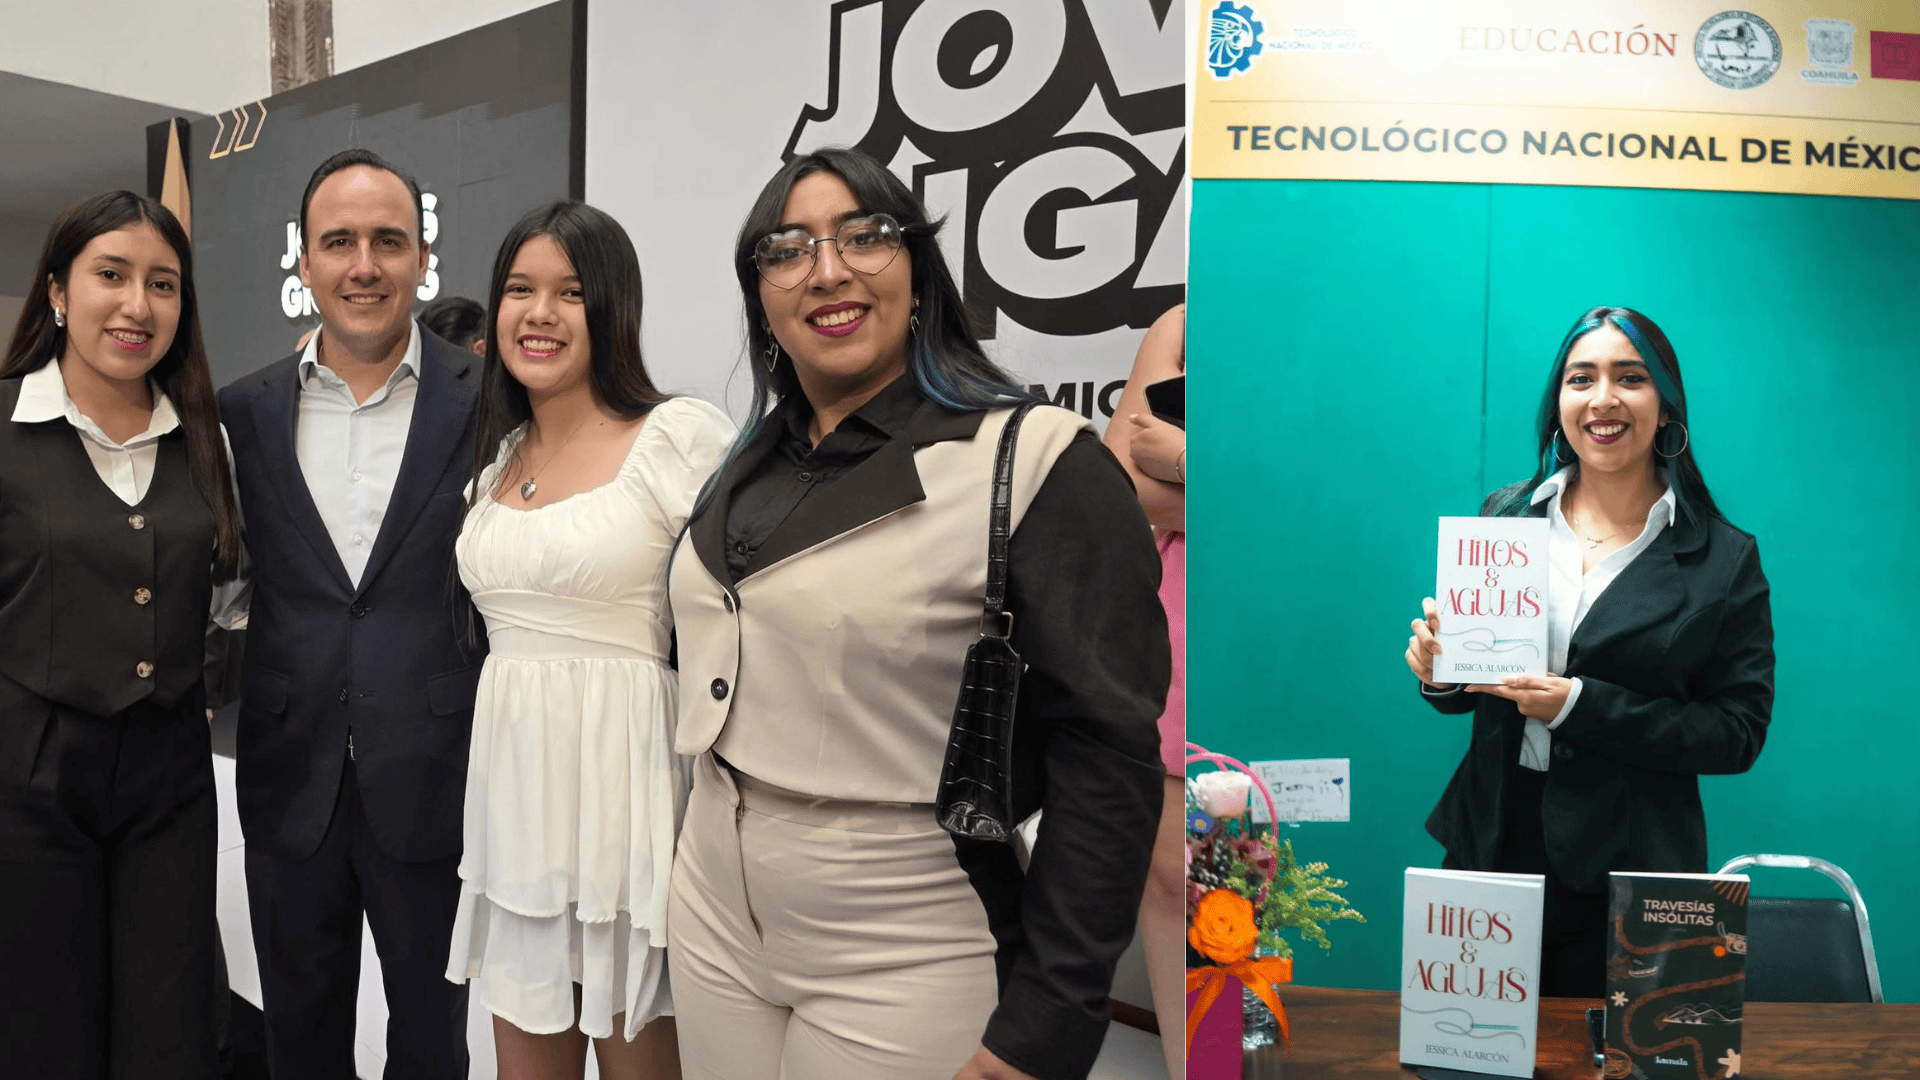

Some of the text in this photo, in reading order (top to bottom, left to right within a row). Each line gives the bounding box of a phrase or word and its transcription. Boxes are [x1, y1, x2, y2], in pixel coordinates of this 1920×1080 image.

[1459, 24, 1678, 57] EDUCACIÓN
[1227, 120, 1508, 155] TECNOLÓGICO
[1523, 131, 1728, 162] NACIONAL
[1741, 138, 1792, 165] DE
[1484, 567, 1500, 588] &
[1441, 586, 1541, 619] AGUJAS
[1454, 663, 1483, 673] JESSICA
[1643, 899, 1716, 914] TRAVESÍAS
[1643, 911, 1715, 927] INSÓLITAS
[1459, 940, 1478, 964] &
[1408, 958, 1529, 1004] AGUJAS
[1425, 1044, 1460, 1058] JESSICA
